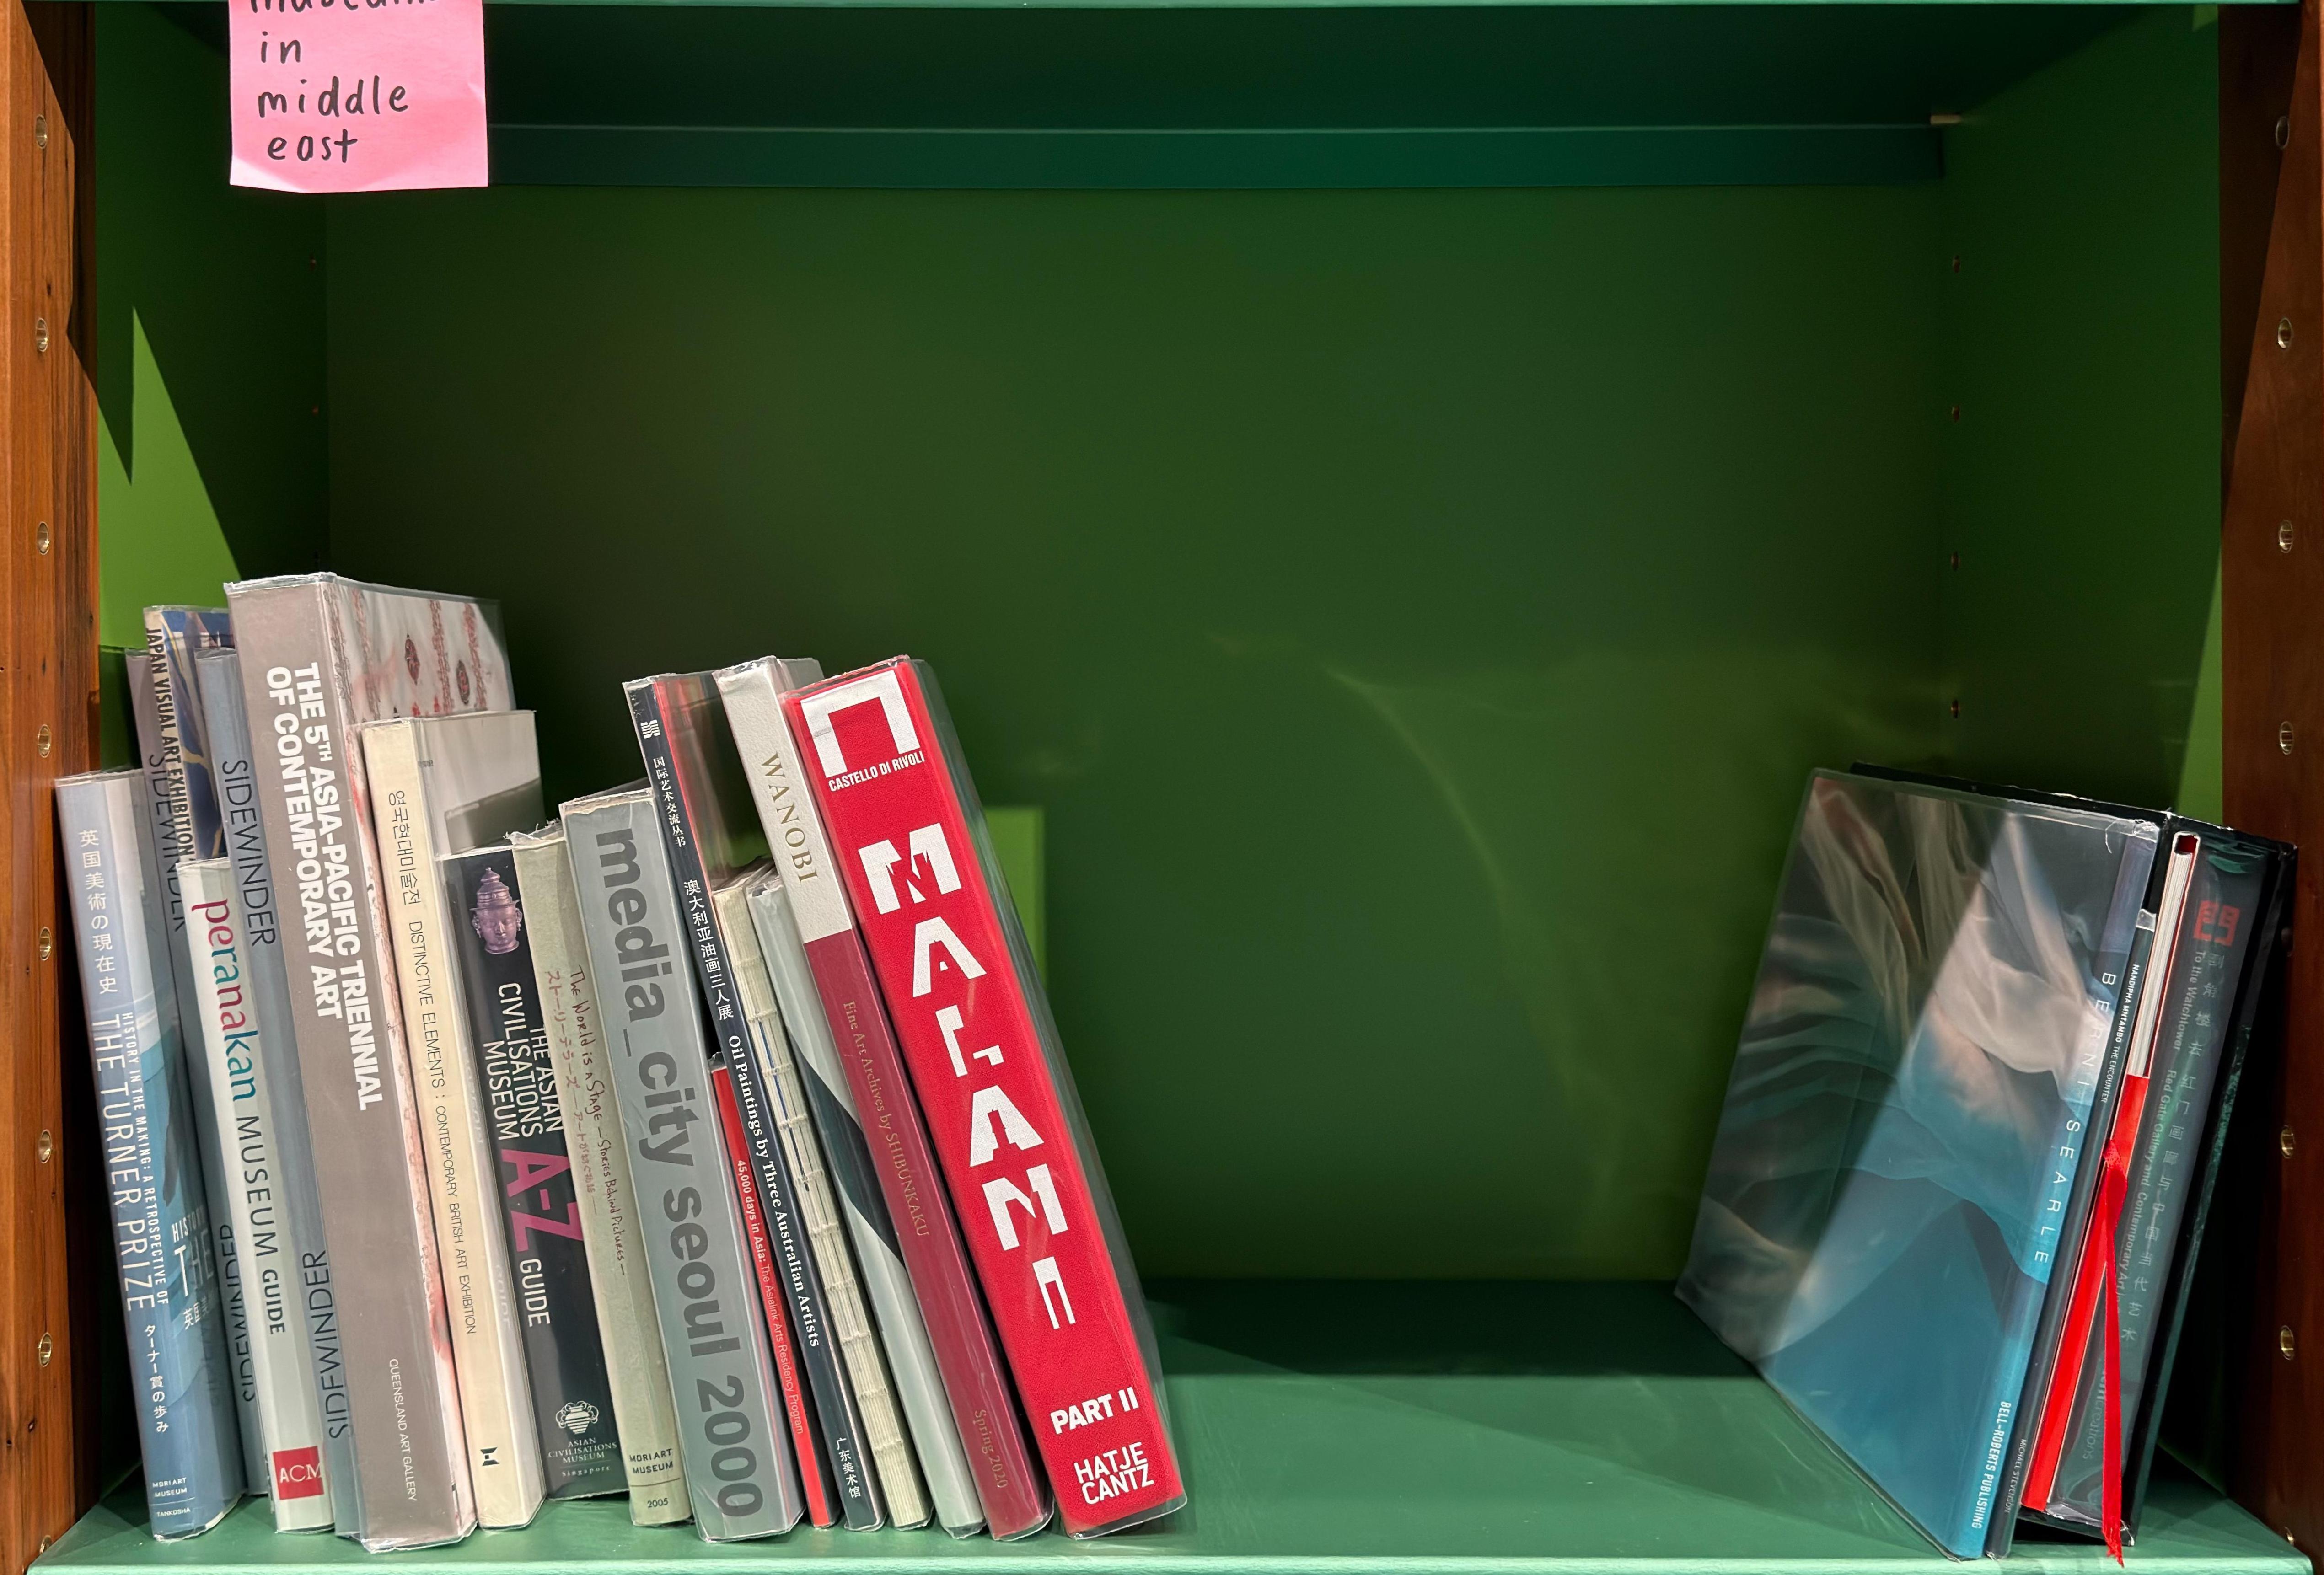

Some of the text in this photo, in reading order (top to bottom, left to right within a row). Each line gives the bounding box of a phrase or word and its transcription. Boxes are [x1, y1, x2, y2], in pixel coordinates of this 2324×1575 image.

[260, 31, 301, 64] in
[258, 75, 408, 118] middle
[268, 129, 358, 163] east
[146, 629, 167, 674] JAPAN
[154, 678, 176, 731] VISUAL
[161, 736, 181, 763] ART
[828, 751, 925, 793] CASTELLO DI RIVOLI
[653, 756, 686, 847] 国际艺术交流丛书
[761, 751, 819, 883] WANOBI
[222, 759, 276, 947] SIDEWINDER
[266, 667, 343, 1019] OF CONTEMPORARY ART
[389, 790, 421, 905] 영국현대미술전
[79, 830, 118, 995] 英国美術の現在史
[295, 662, 383, 1111] THE 5TH ASIA-PACIFIC TRIENNIAL
[409, 921, 434, 1006] DISTINCTIVE
[683, 879, 734, 1021] 澳大利亚油画三人展
[2189, 966, 2202, 983] the
[2194, 951, 2206, 963] To
[422, 1012, 445, 1088] ELEMENTS
[2100, 964, 2140, 1103] NANDIPHA MNTAMBO THE ENCOUNTER
[2173, 986, 2198, 1051] Watchtower
[483, 1040, 520, 1140] MUSEUM
[498, 983, 543, 1138] CIVILISATIONS
[530, 1028, 563, 1132] THE ASIAN
[2163, 1069, 2177, 1093] Red
[191, 898, 285, 1336] peranakan MUSEUM GUIDE
[853, 1033, 867, 1055] Art
[861, 1058, 885, 1112] Archives
[879, 1114, 891, 1130] by
[886, 1132, 929, 1237] SHIBUNKAKU
[2034, 972, 2117, 1264] BERNI SEARLE
[92, 1013, 155, 1312] THE TURNER PRIZE
[122, 1012, 169, 1305] HISTORY IN THE MAKING: A RETROSPECTIVE OF
[436, 1106, 457, 1197] CONTEMPORARY
[596, 828, 764, 1517] media_city seoul 2000
[2141, 1162, 2152, 1186] and
[449, 1203, 464, 1243] BRITISH
[729, 1035, 820, 1348] Oil Paintings by Three Australian Artists
[456, 1248, 468, 1270] ART
[501, 1149, 584, 1328] A-Z GUIDE
[2119, 1192, 2148, 1270] Contemporary
[459, 1275, 476, 1334] EXHIBITION
[737, 1160, 804, 1435] 45,000 days in Asia: The Asialink Arts Residency Program
[302, 1250, 349, 1439] SIDEWINDER
[145, 1324, 169, 1433] ターナー賞の歩み
[1050, 1387, 1139, 1435] PART II
[389, 1358, 418, 1501] QUEENSLAND ART GALLERY
[548, 1442, 617, 1457] CIVILISATIONS
[563, 1451, 605, 1464] MUSEUM
[568, 1438, 596, 1448] ASIAN
[629, 1448, 672, 1463] MORI ART
[973, 1409, 1009, 1489] Spring 2020
[2013, 1438, 2027, 1469] MICHAEL
[155, 1487, 188, 1498] MUSEUM
[172, 1477, 187, 1486] ART
[279, 1463, 322, 1484] ACM
[562, 1465, 611, 1477] Singapore
[633, 1461, 673, 1475] MUSEUM
[836, 1437, 861, 1499] 广东美术馆
[1074, 1441, 1148, 1484] HATJE
[1081, 1463, 1154, 1505] CANTZ
[1971, 1401, 2012, 1530] BELL-ROBERTS PUBLISHING
[156, 1506, 191, 1517] TANKOSHA
[647, 1497, 669, 1509] 2005
